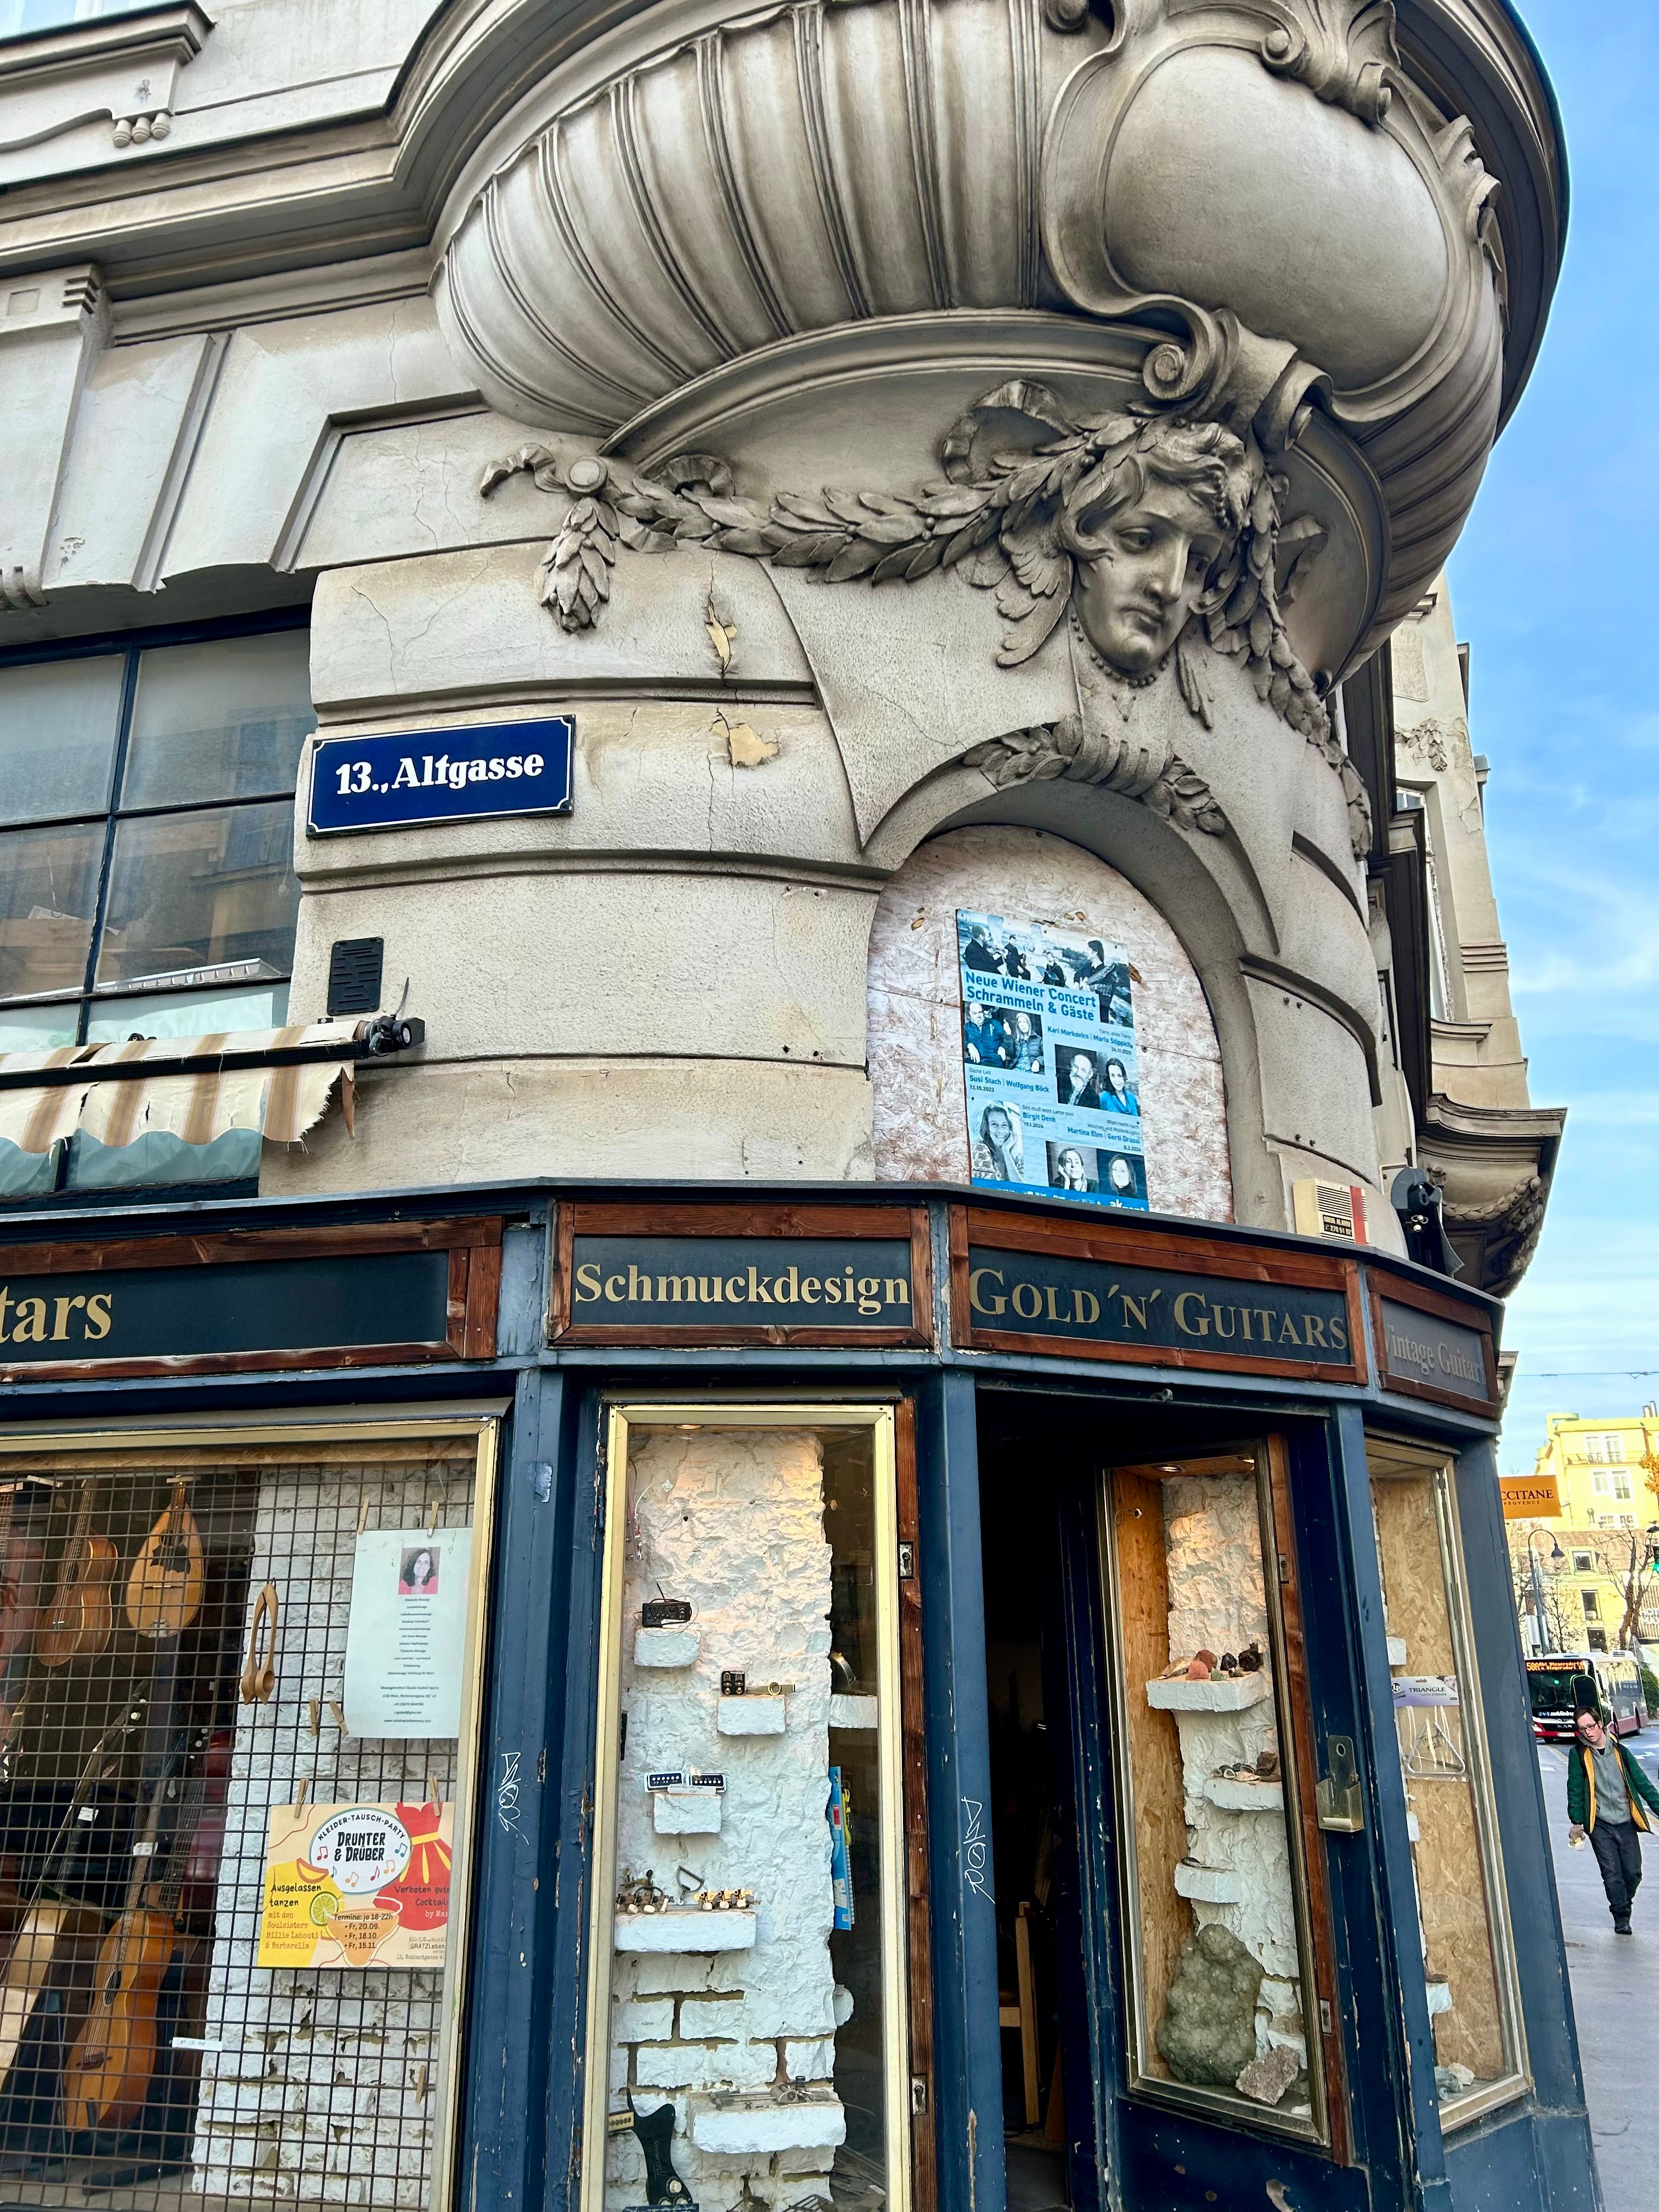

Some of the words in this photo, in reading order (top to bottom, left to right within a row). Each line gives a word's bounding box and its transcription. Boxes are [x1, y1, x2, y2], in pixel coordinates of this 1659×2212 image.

[391, 753, 544, 790] Altgasse
[966, 971, 997, 988] Neue
[1001, 978, 1045, 997] Wiener
[1048, 988, 1096, 1007] Concert
[967, 986, 1043, 1012] Schrammeln
[1048, 1002, 1057, 1014] &
[1061, 1004, 1094, 1021] Gäste
[1047, 1026, 1060, 1034] Karl
[1061, 1029, 1089, 1040] Markovics
[969, 1075, 983, 1083] Susi
[985, 1076, 1002, 1085] Stach
[1006, 1080, 1034, 1092] Wolfgang
[1023, 1111, 1040, 1121] Birgit
[1041, 1114, 1057, 1122] Denk
[1068, 1126, 1090, 1136] Martina
[574, 1263, 911, 1316] Schmuckdesign
[0, 1286, 112, 1344] tars
[969, 1268, 1101, 1324] GOLD
[1173, 1291, 1348, 1350] GUITARS
[318, 1814, 405, 1841] KLEIDER-TAUSCH-PARTY
[337, 1831, 386, 1847] DRUNTER
[334, 1848, 342, 1861] &
[345, 1844, 385, 1862] DRÜBER
[270, 1882, 321, 1894] Ausgelassen
[269, 1898, 299, 1907] tanzen
[425, 1910, 435, 1919] by
[348, 1932, 358, 1940] Fr,
[272, 1941, 309, 1949] Barbarella
